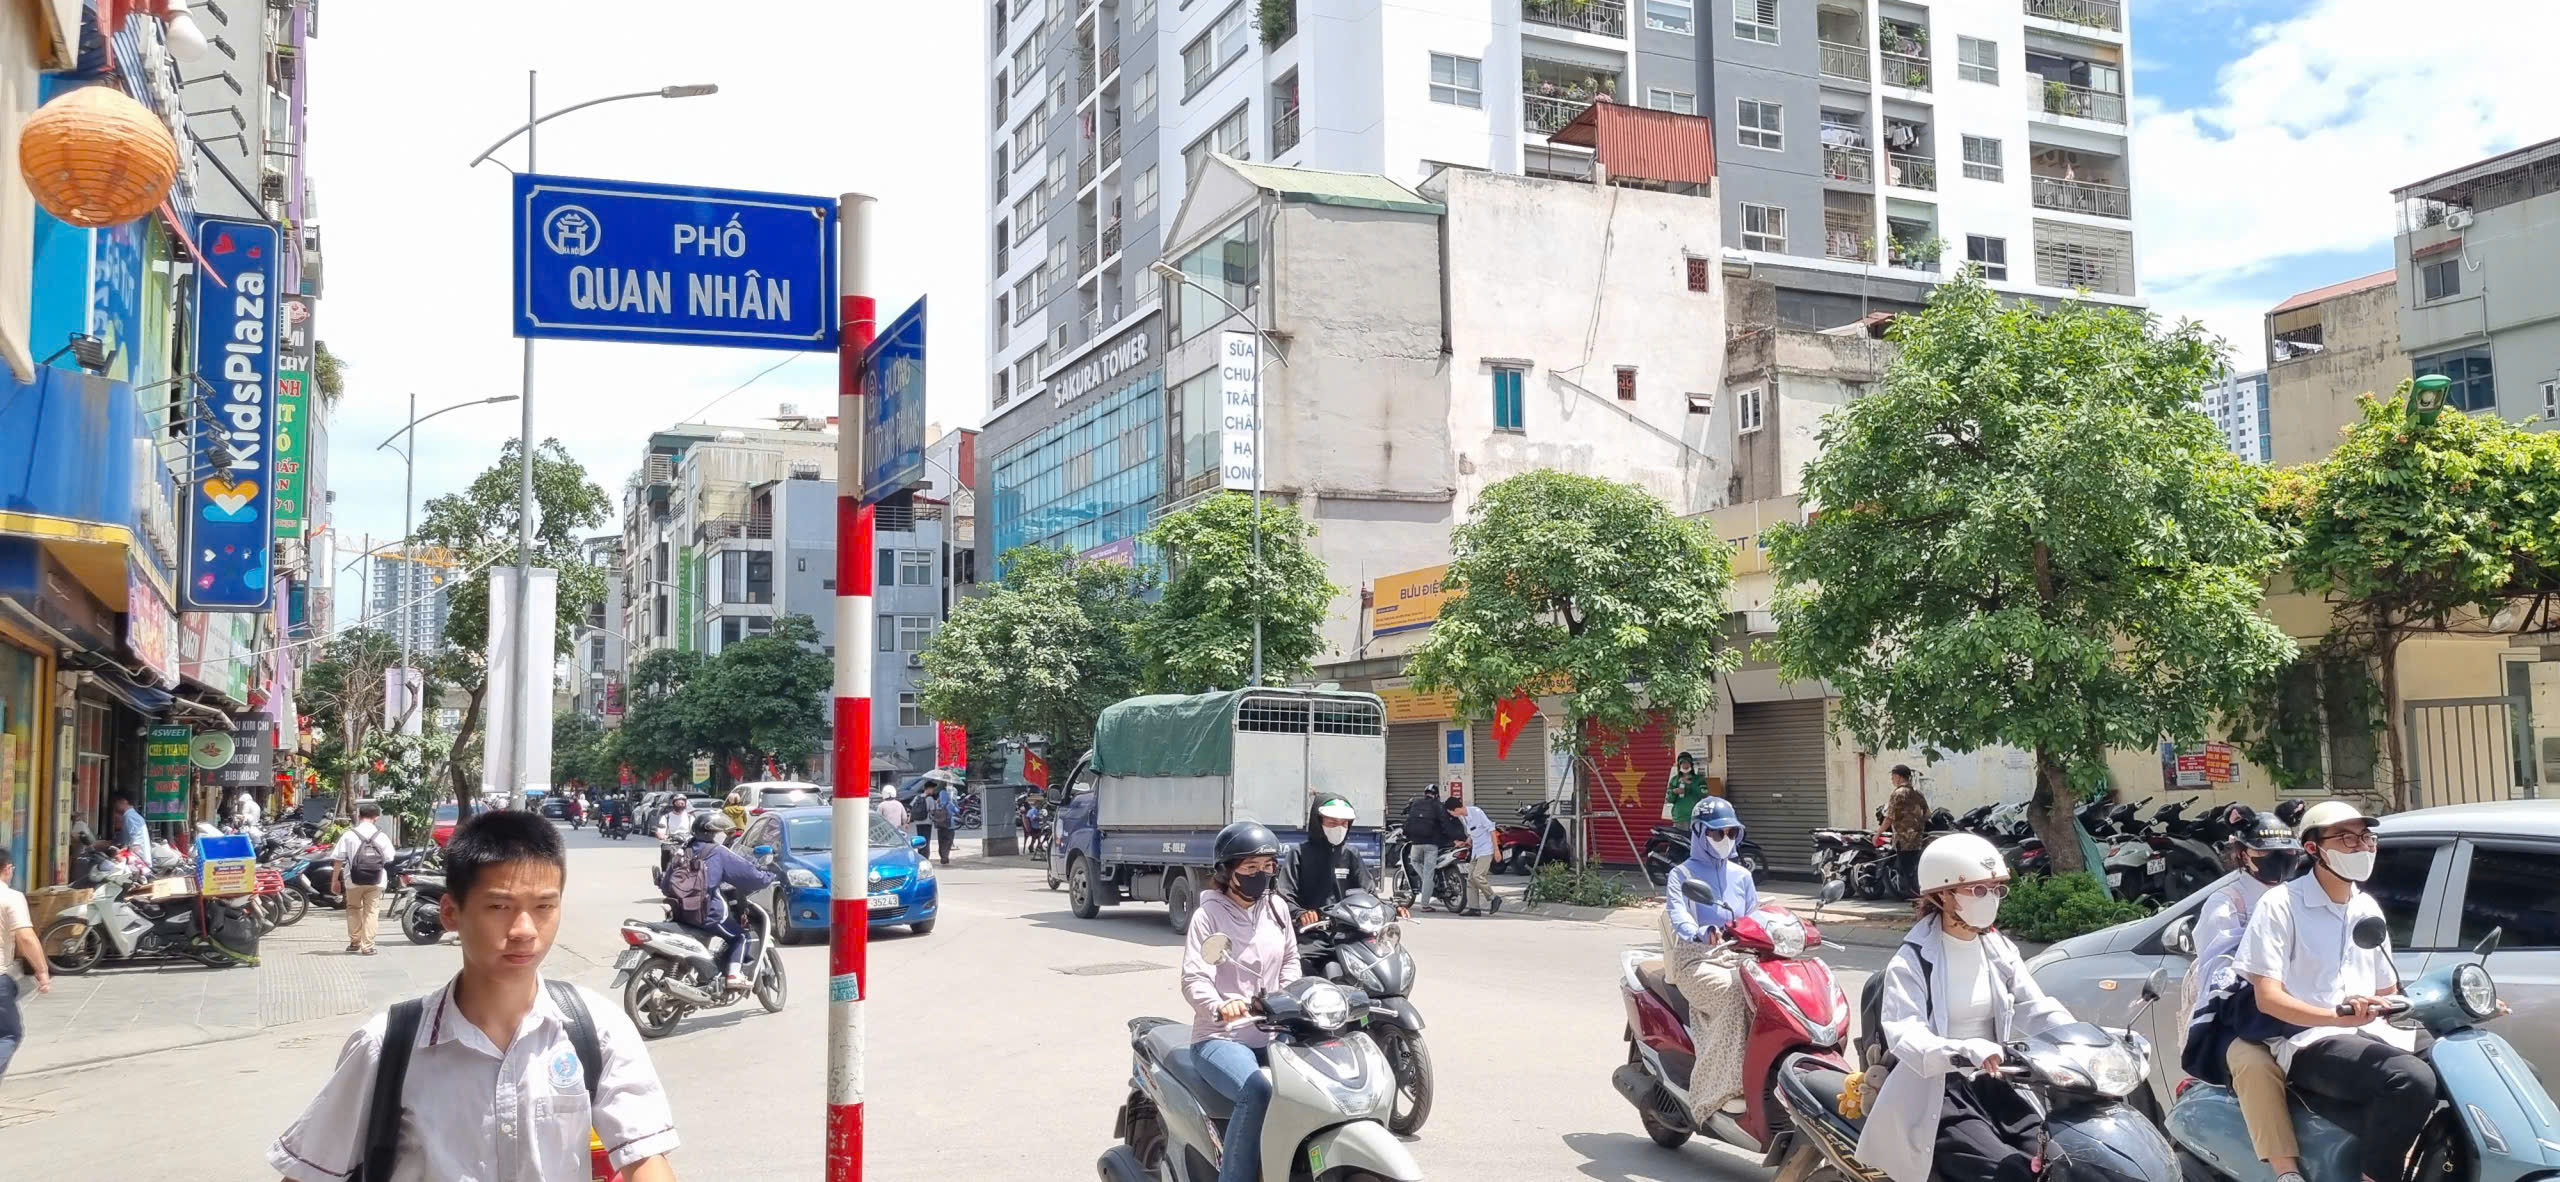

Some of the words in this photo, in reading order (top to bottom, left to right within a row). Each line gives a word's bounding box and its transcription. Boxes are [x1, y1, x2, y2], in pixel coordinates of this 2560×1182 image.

[673, 212, 747, 259] PHỐ
[569, 265, 671, 314] QUAN
[688, 269, 791, 322] NHÂN
[1229, 339, 1255, 357] SỮA
[220, 272, 265, 470] KidsPlaza
[1054, 361, 1101, 409] SAKURA
[1100, 333, 1149, 379] TOWER
[1233, 440, 1253, 458] HẠ
[1400, 584, 1421, 600] BƯU
[152, 728, 188, 737] 4SWEET
[242, 720, 256, 731] KIM
[257, 720, 270, 731] CHI
[225, 770, 260, 781] BIBIMBAP
